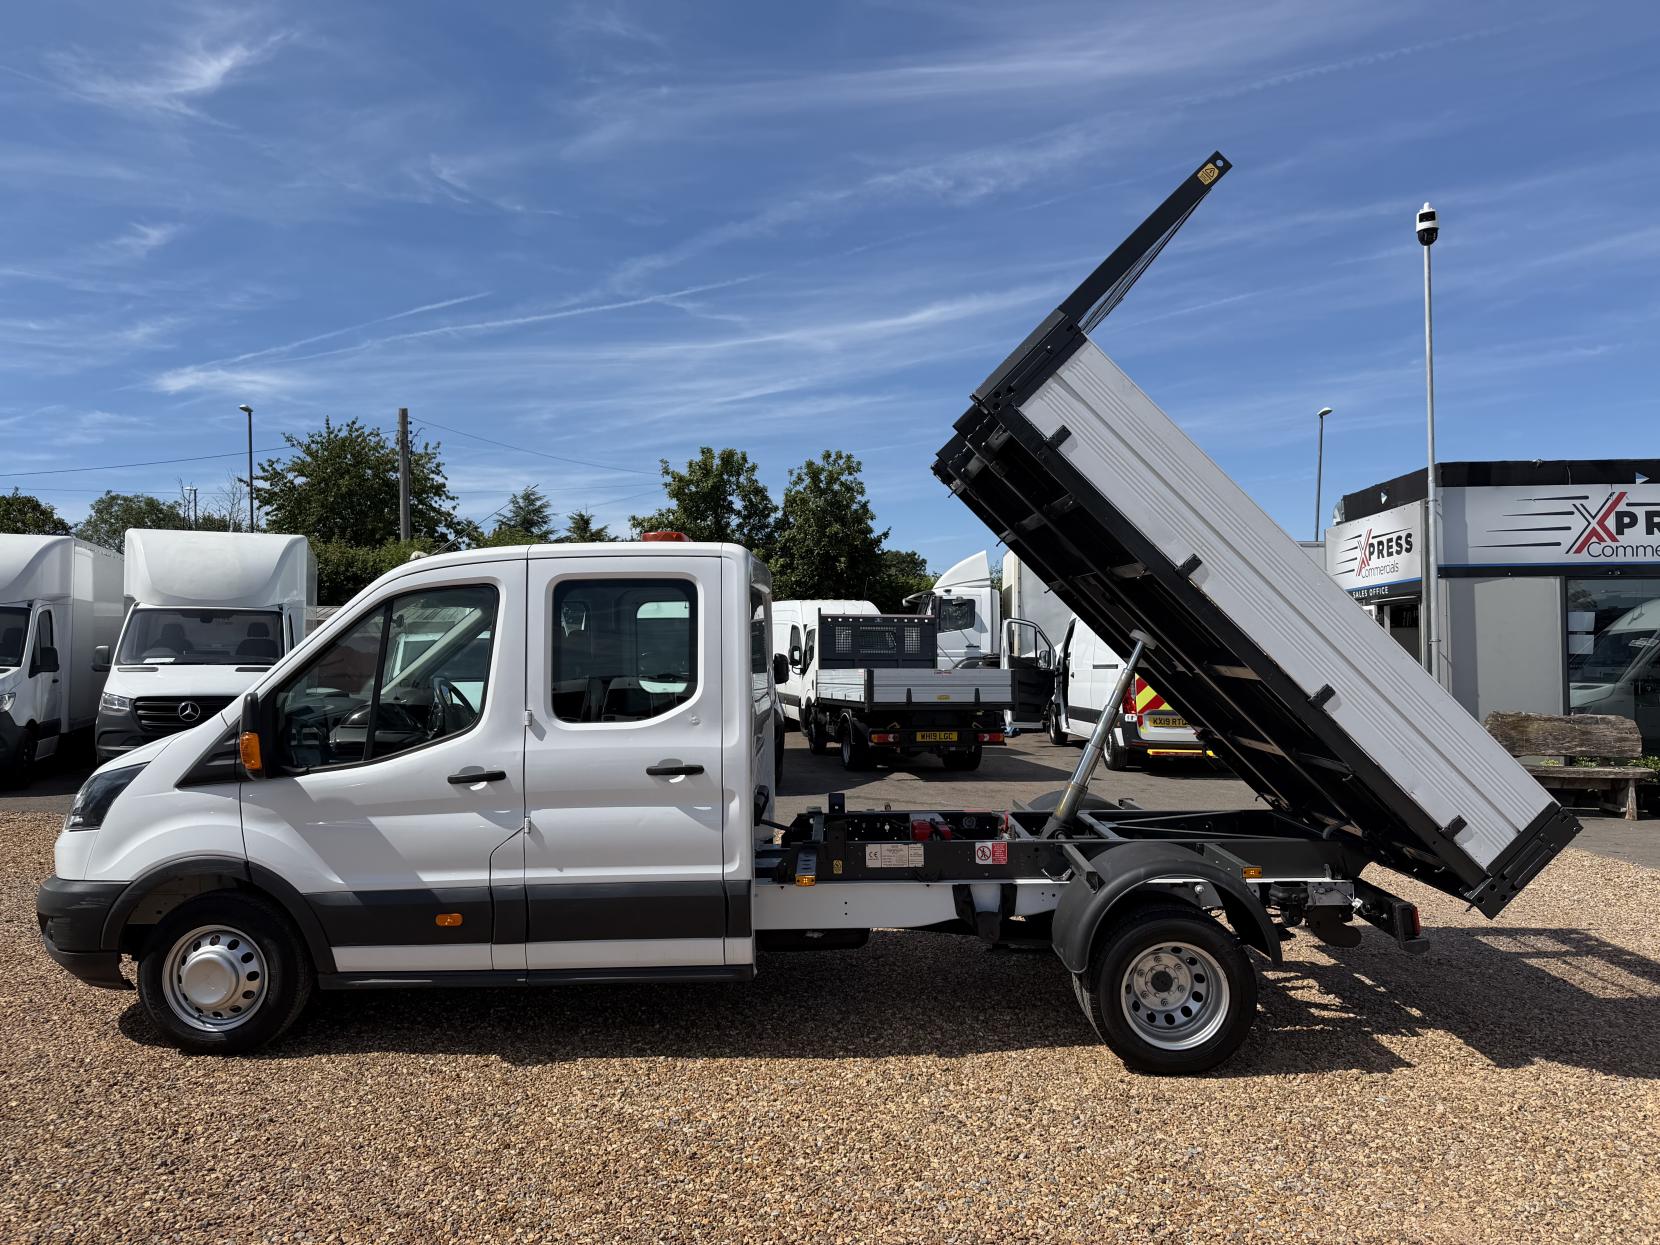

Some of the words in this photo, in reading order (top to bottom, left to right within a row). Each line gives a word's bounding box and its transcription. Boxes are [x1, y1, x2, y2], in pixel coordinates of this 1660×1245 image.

[1356, 528, 1413, 576] XPRESS
[1361, 560, 1399, 578] Commercials
[1353, 590, 1368, 599] SALES
[1369, 586, 1389, 597] OFFICE
